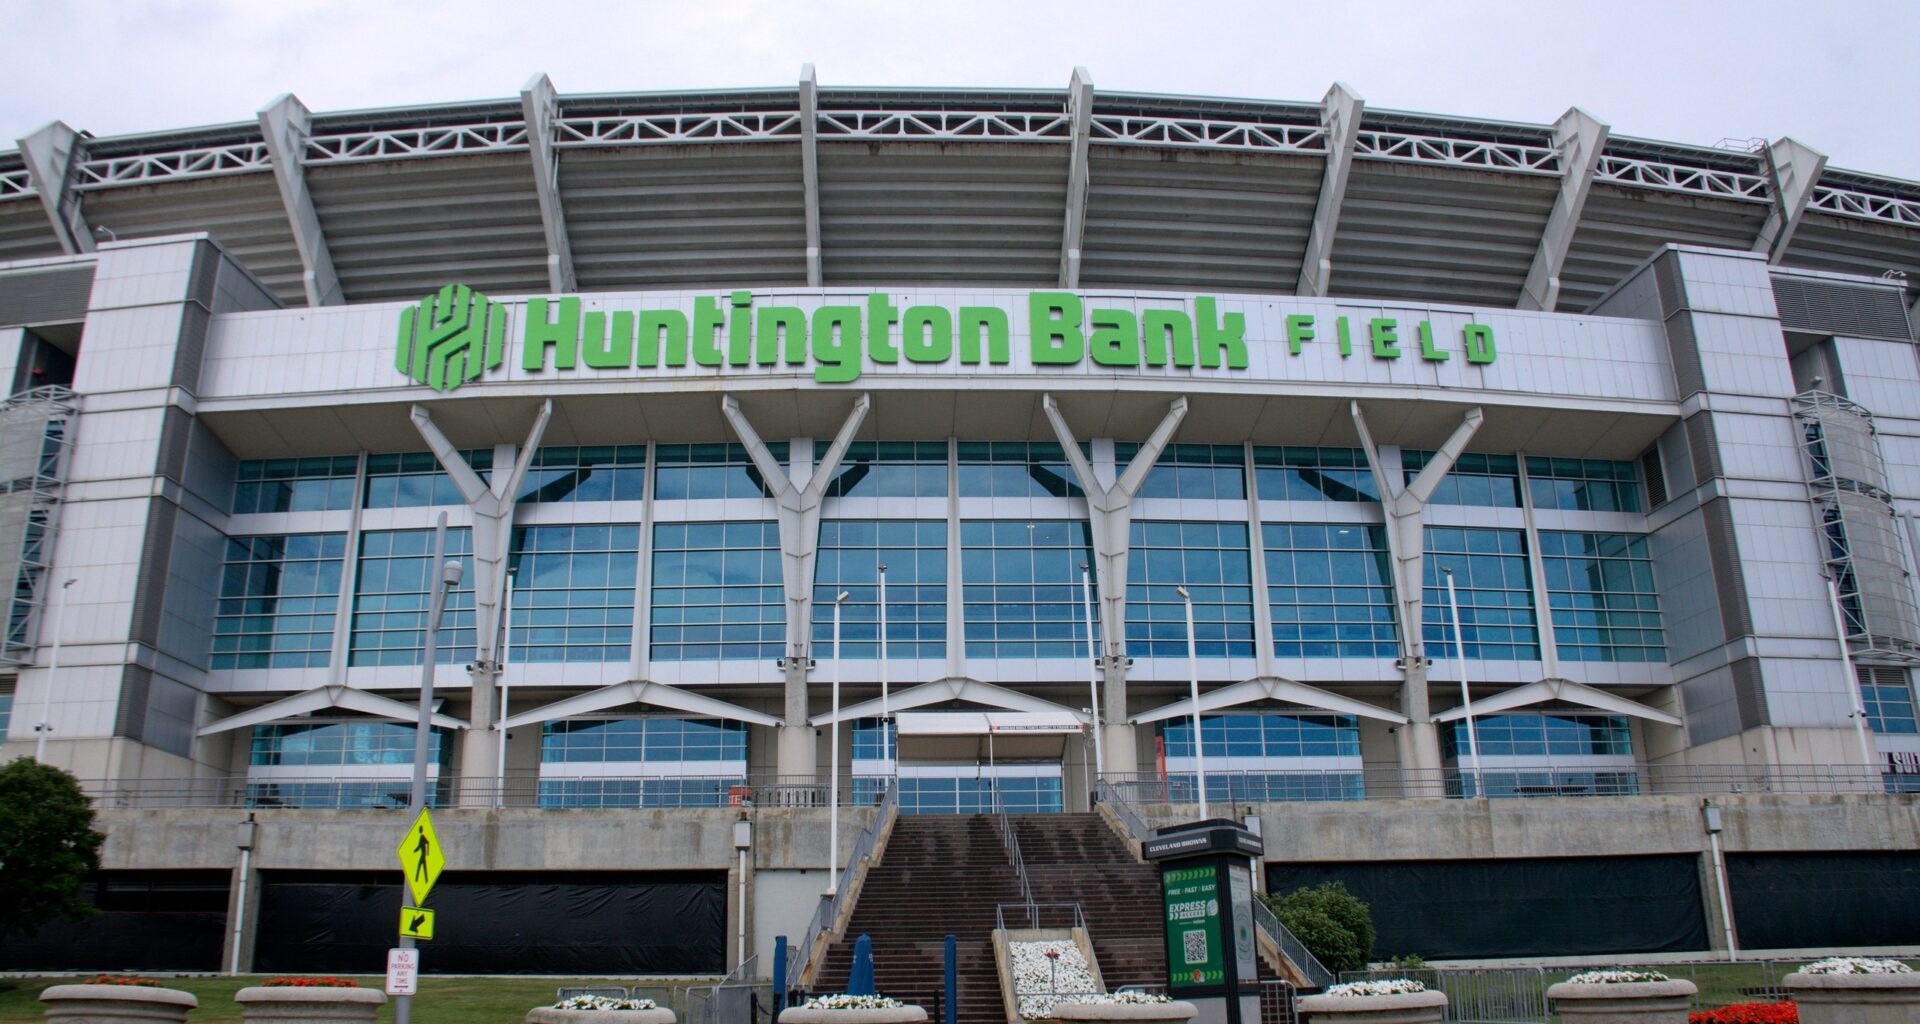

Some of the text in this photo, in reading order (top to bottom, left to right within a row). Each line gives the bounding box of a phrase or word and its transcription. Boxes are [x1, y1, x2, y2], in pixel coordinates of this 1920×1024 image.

[522, 290, 1498, 383] Huntington Bank FIELD
[1149, 837, 1207, 852] CLEVELAND BROWNS
[1168, 884, 1216, 896] FREE FAST EASY
[1169, 900, 1206, 912] EXPRESS
[398, 954, 408, 963] NO
[395, 977, 408, 985] TIME
